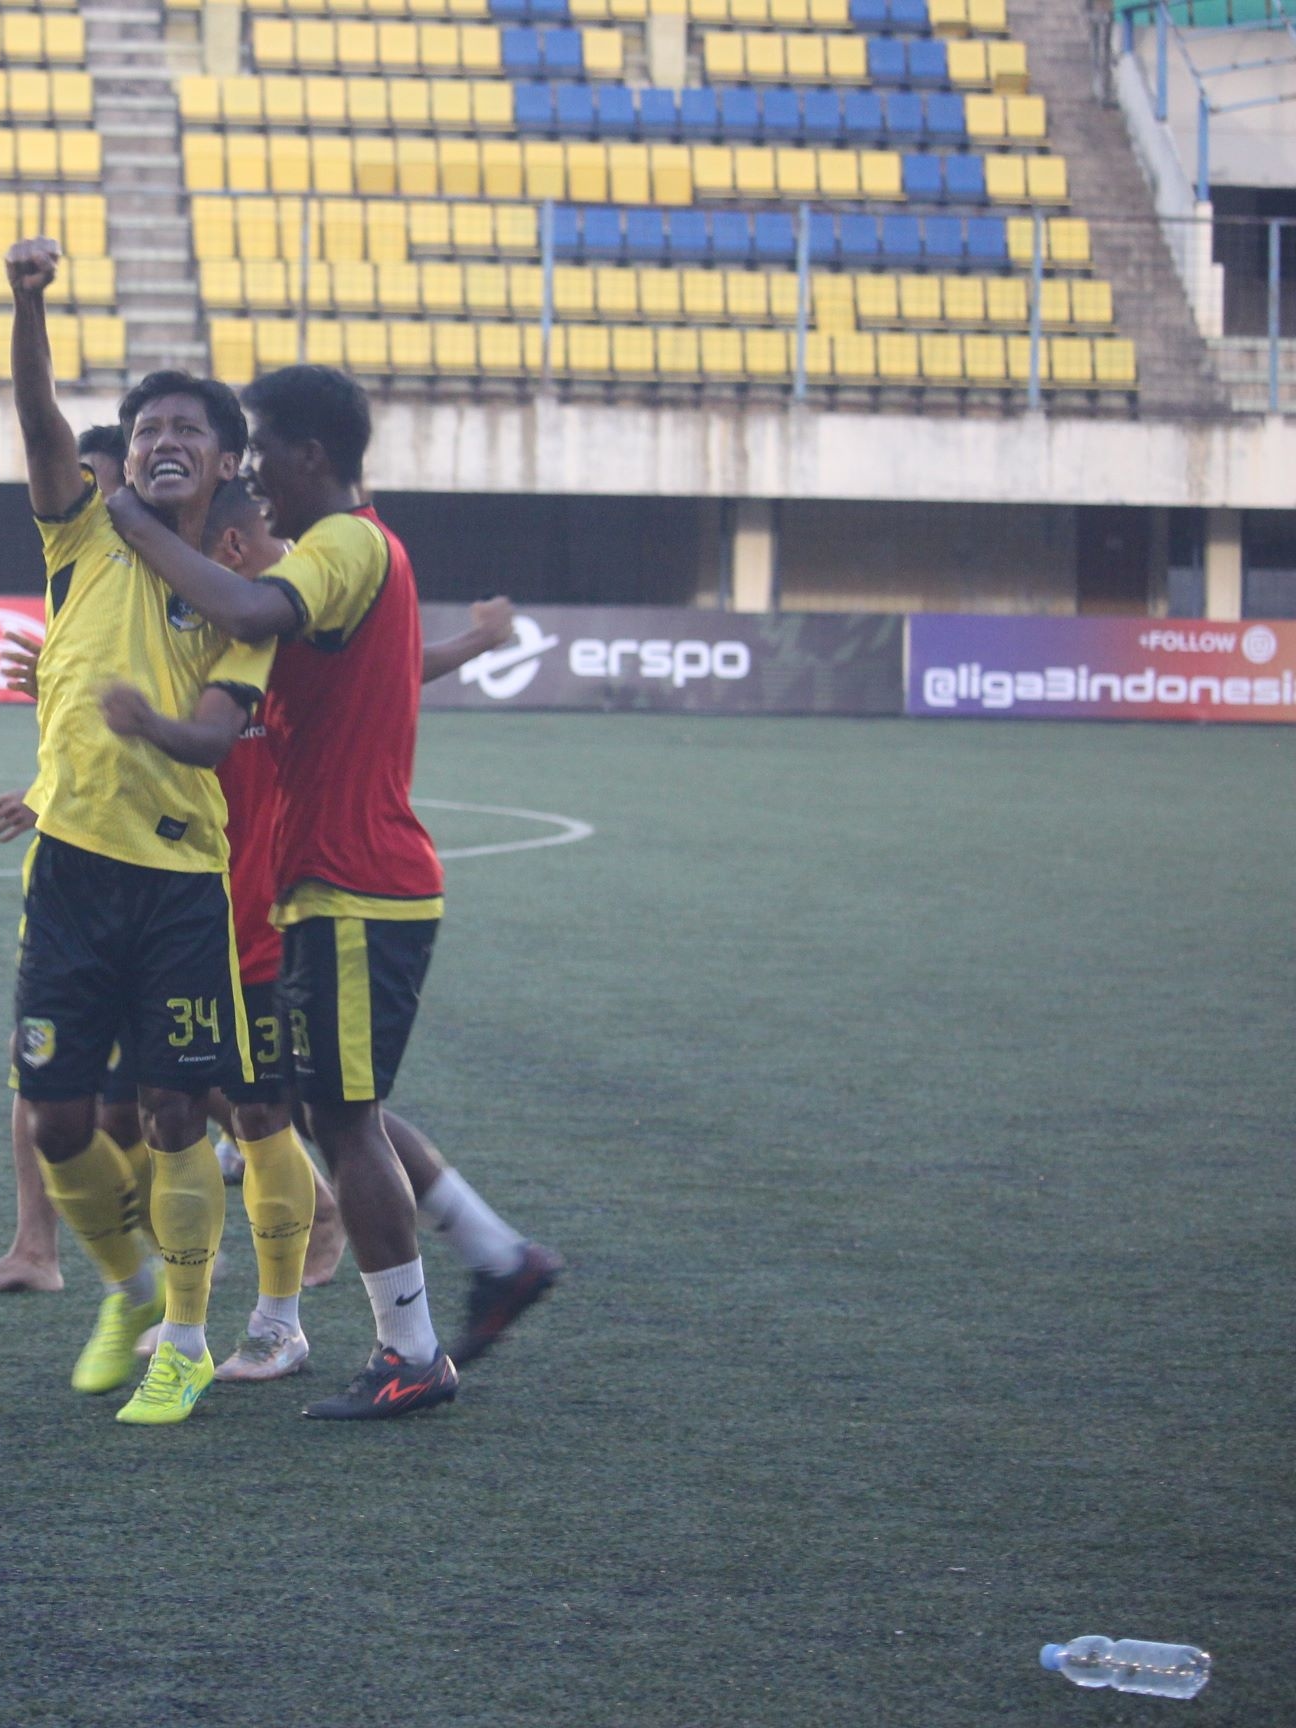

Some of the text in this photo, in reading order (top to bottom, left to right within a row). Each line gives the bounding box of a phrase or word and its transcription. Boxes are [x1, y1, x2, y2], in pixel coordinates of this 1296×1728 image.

[568, 638, 750, 688] erspo
[923, 662, 1296, 709] @liga3indonesi
[166, 996, 221, 1047] 34
